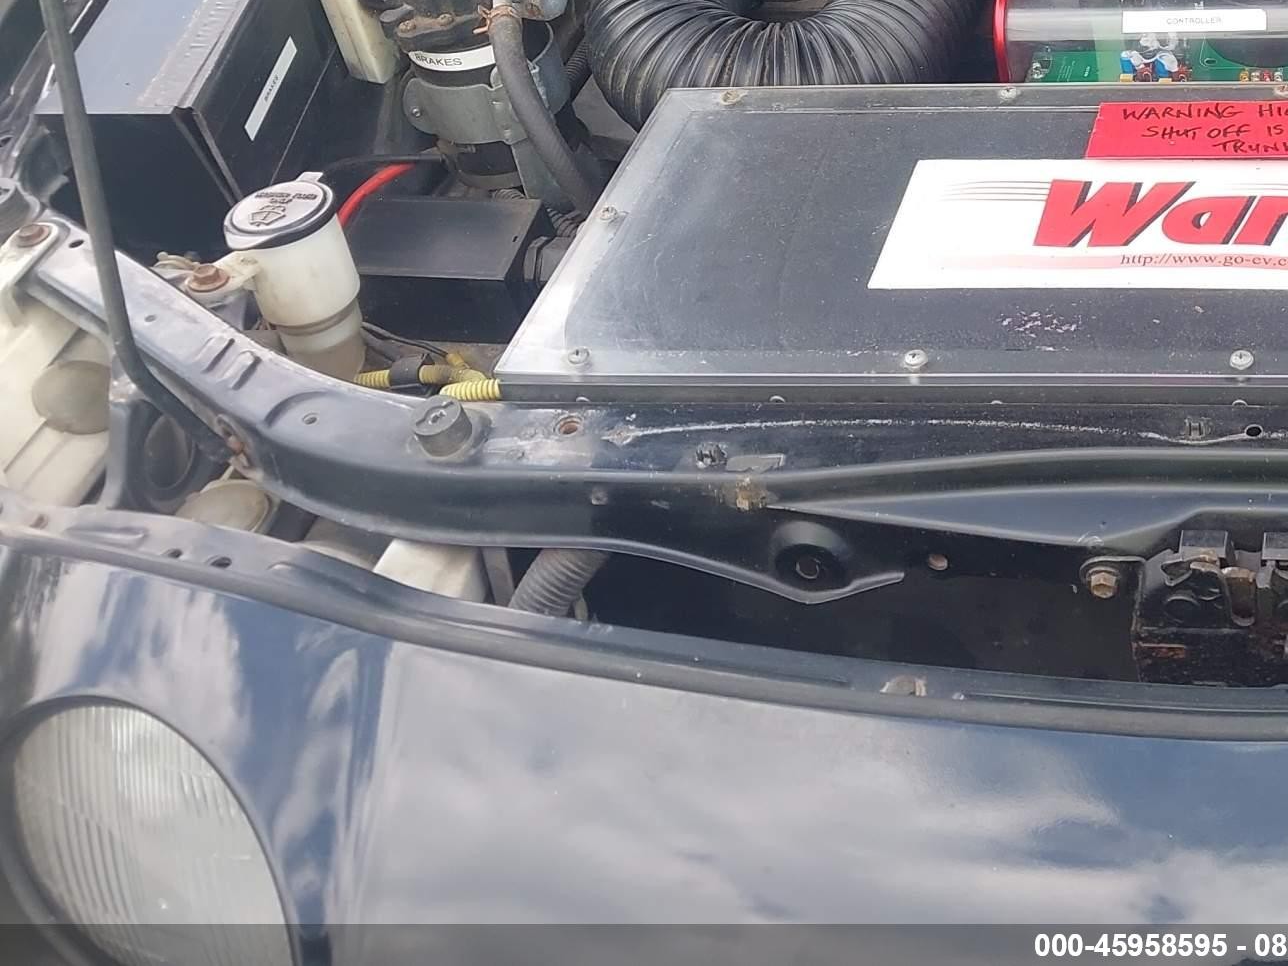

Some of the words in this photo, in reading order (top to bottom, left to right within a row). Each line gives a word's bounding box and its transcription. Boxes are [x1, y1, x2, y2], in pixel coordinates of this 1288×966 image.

[1166, 17, 1222, 25] CONTROLLER
[413, 52, 462, 68] BRAKES
[1122, 103, 1243, 120] WARNING
[1142, 126, 1201, 140] SHUT
[1206, 124, 1250, 139] OFF
[1267, 126, 1284, 137] IS
